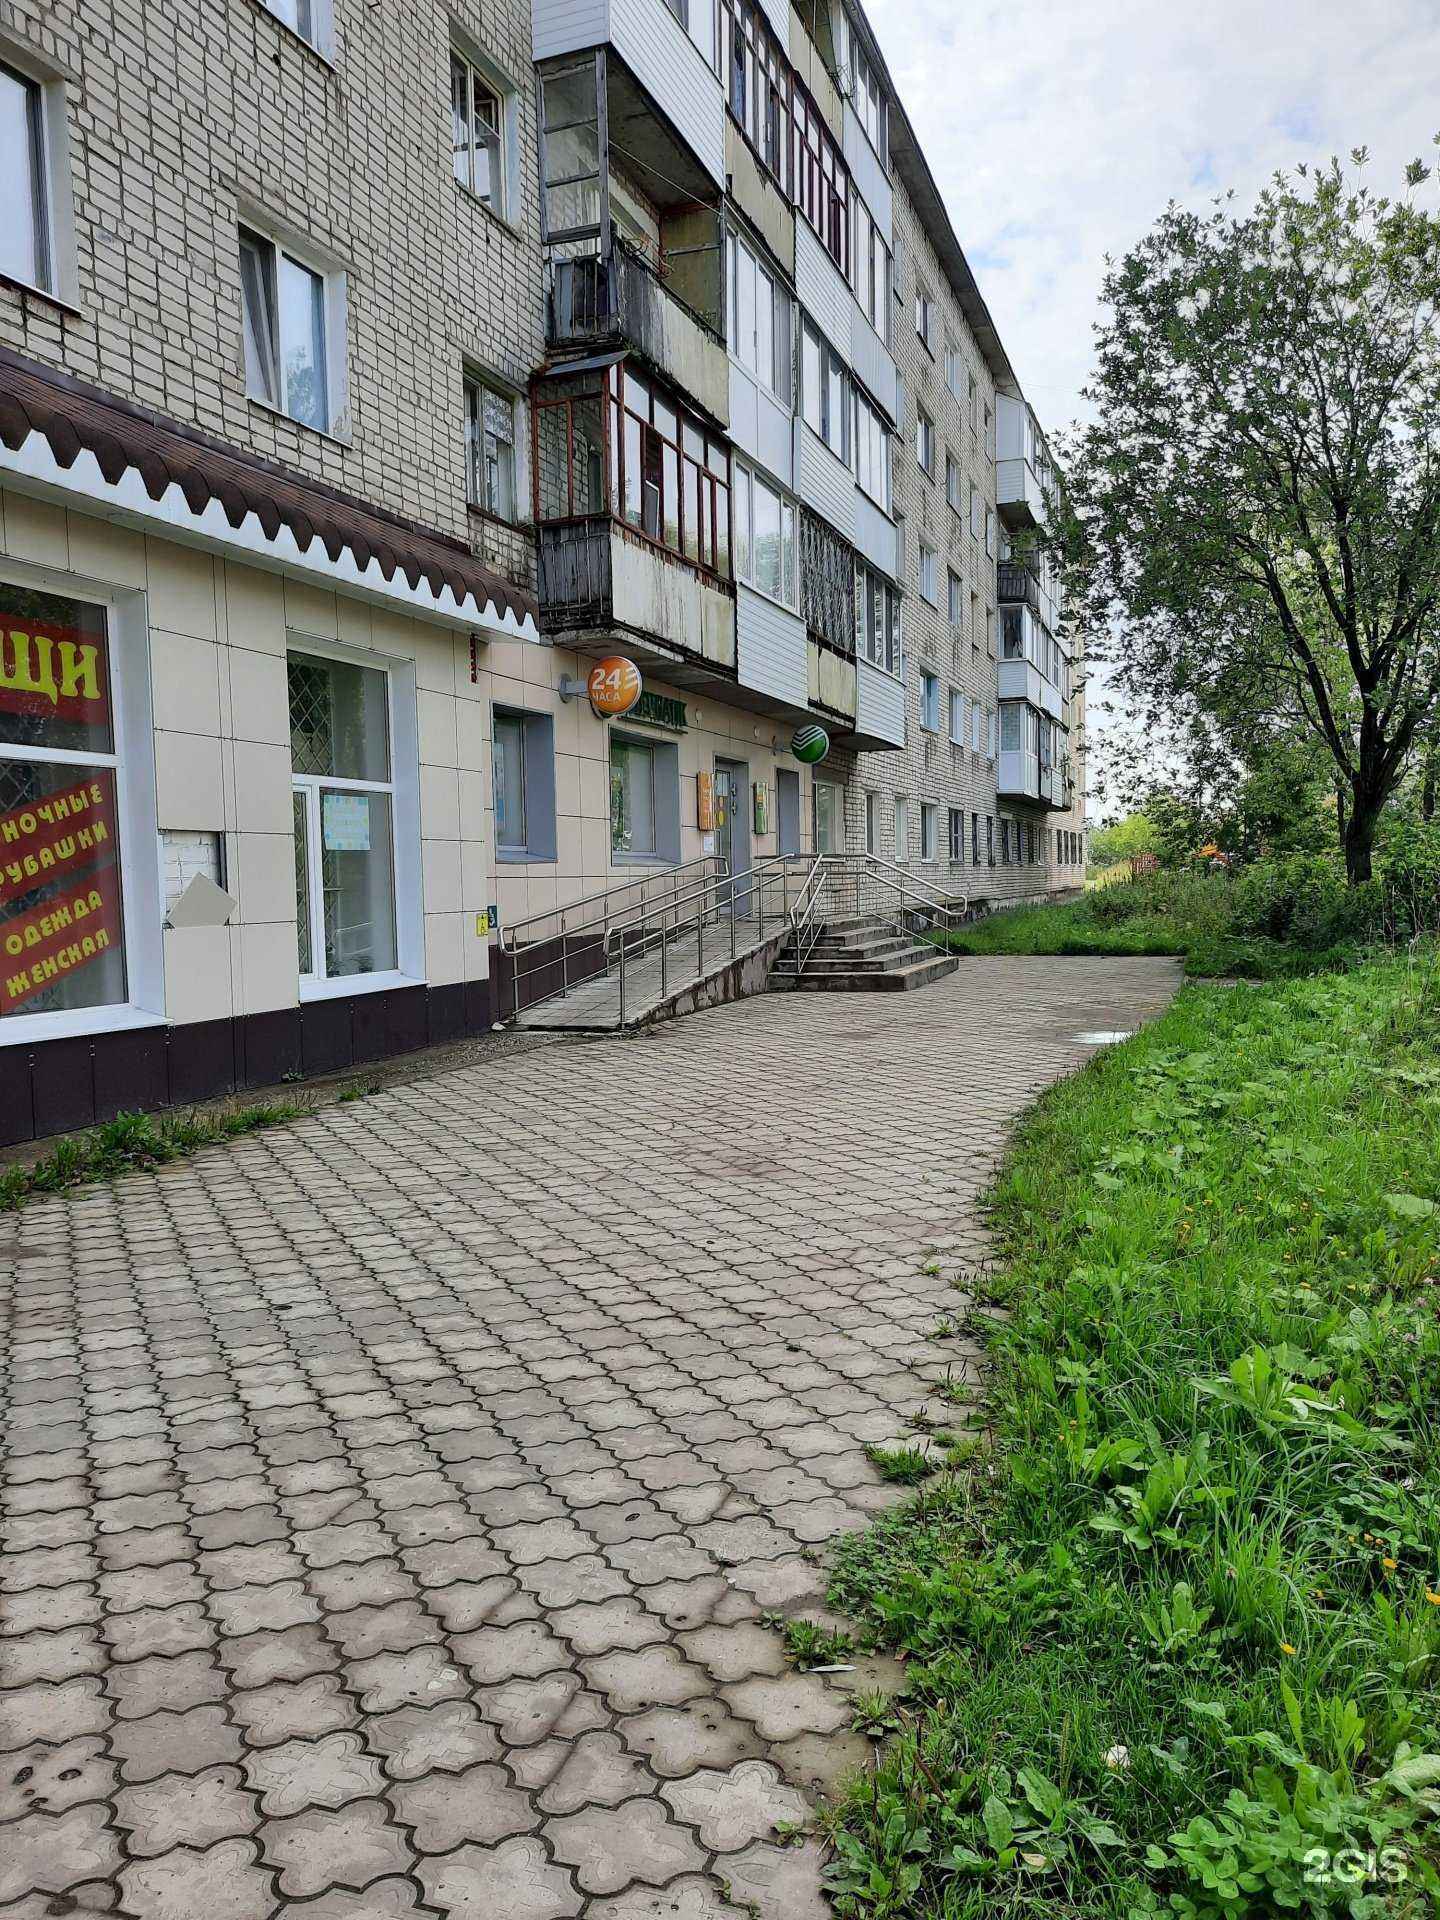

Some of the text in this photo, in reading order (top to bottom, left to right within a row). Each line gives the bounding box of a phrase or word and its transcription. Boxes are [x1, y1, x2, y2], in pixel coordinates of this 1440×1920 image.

[591, 691, 621, 704] ЧАСА
[592, 668, 621, 690] 24
[1, 784, 103, 843] НОЧНЫЕ
[6, 890, 103, 955] ОДЕЖДА
[6, 928, 110, 998] ЖЕНСКАЯ
